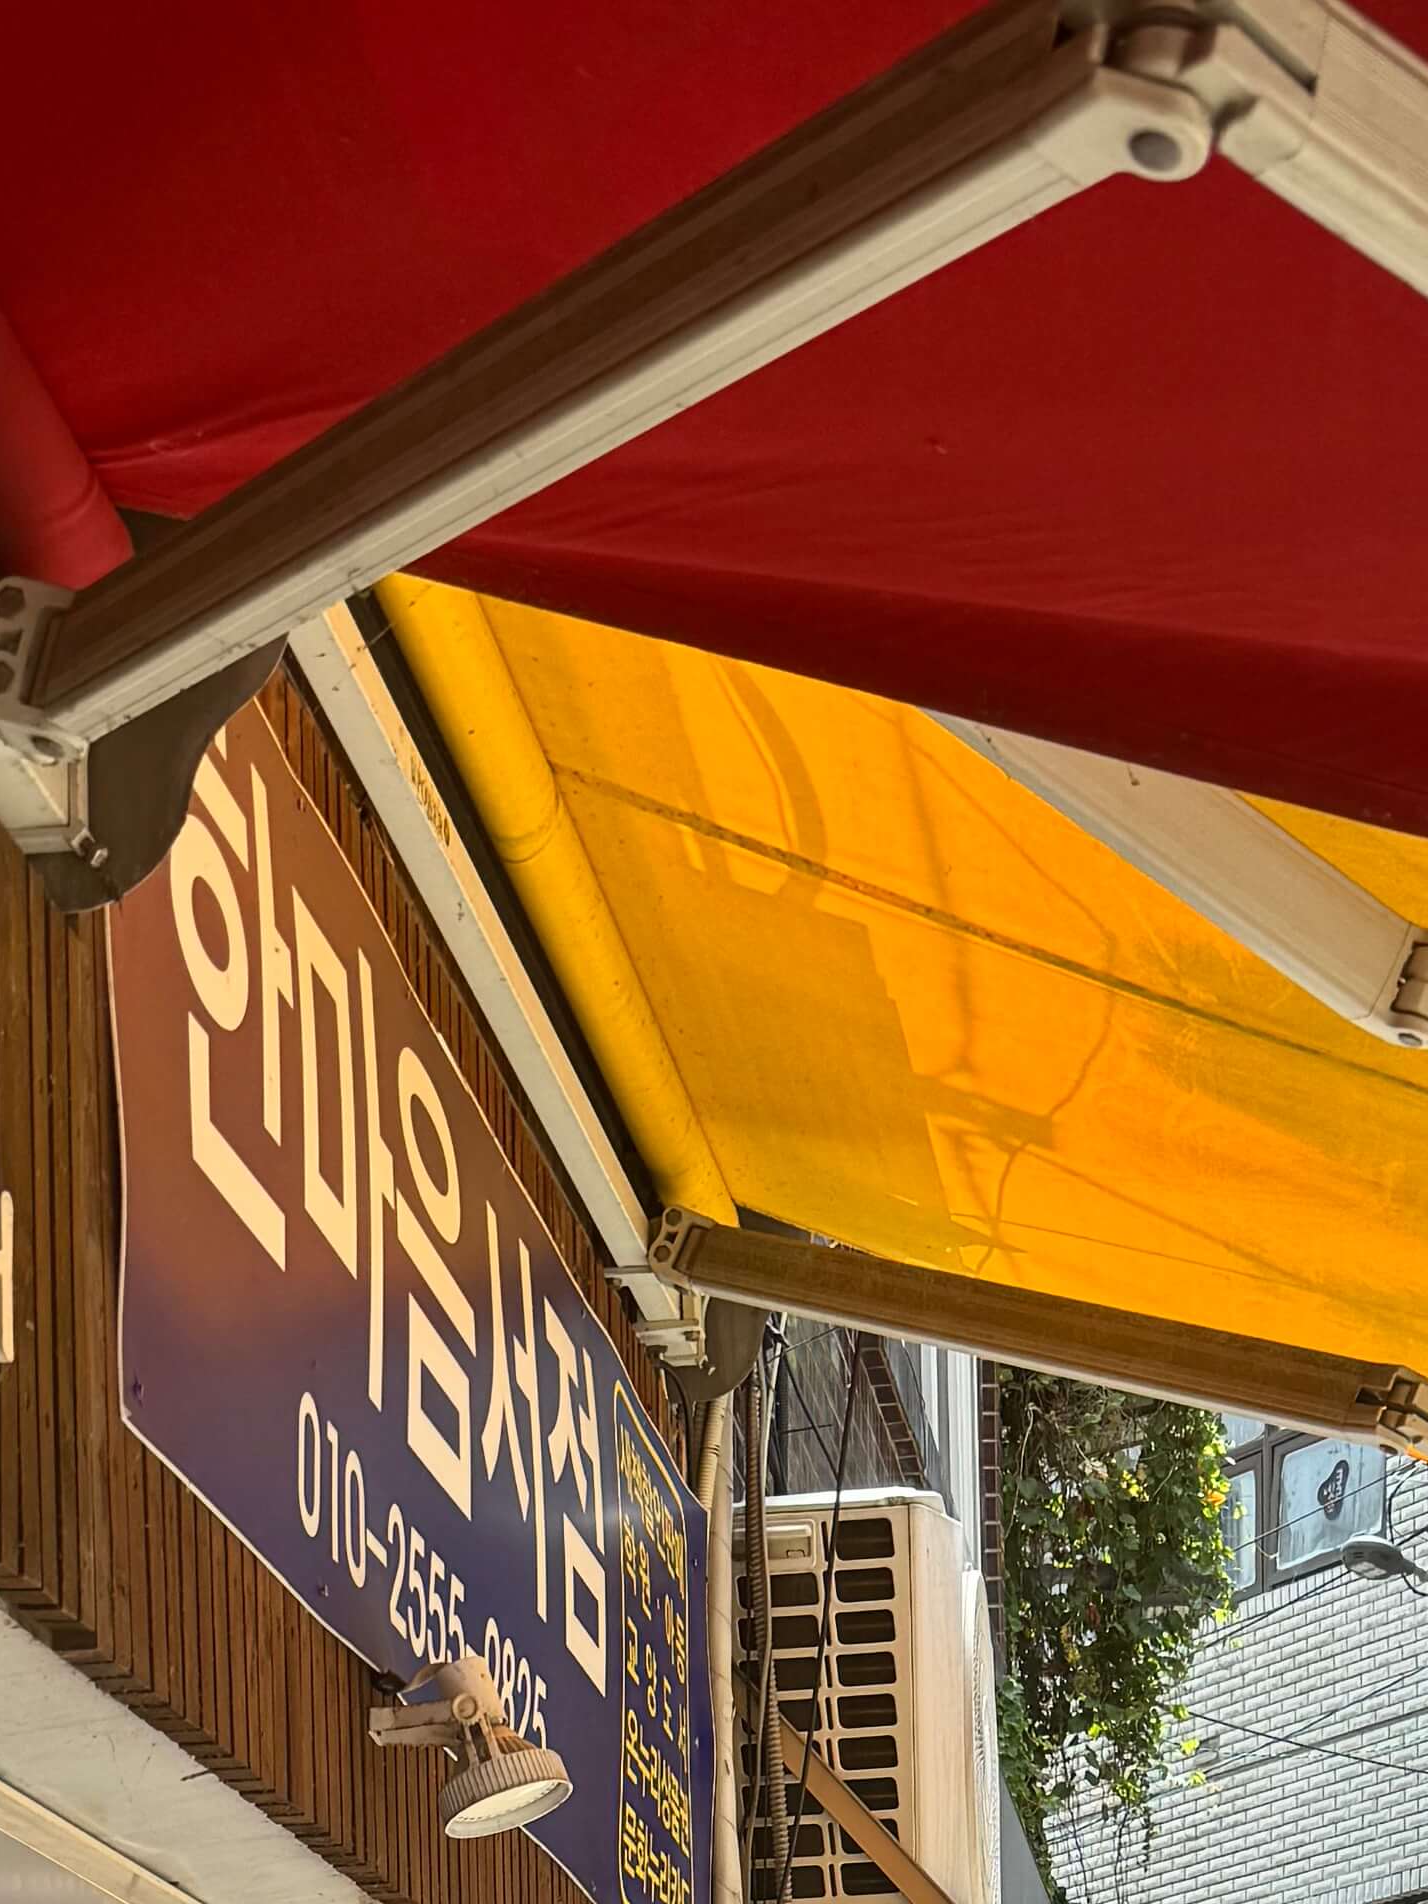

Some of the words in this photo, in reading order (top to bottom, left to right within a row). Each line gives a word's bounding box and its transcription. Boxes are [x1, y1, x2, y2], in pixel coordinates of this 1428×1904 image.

[170, 715, 608, 1700] 한마음서점
[618, 1424, 685, 1598] 새책할인판매
[625, 1707, 691, 1858] 온누리상품권
